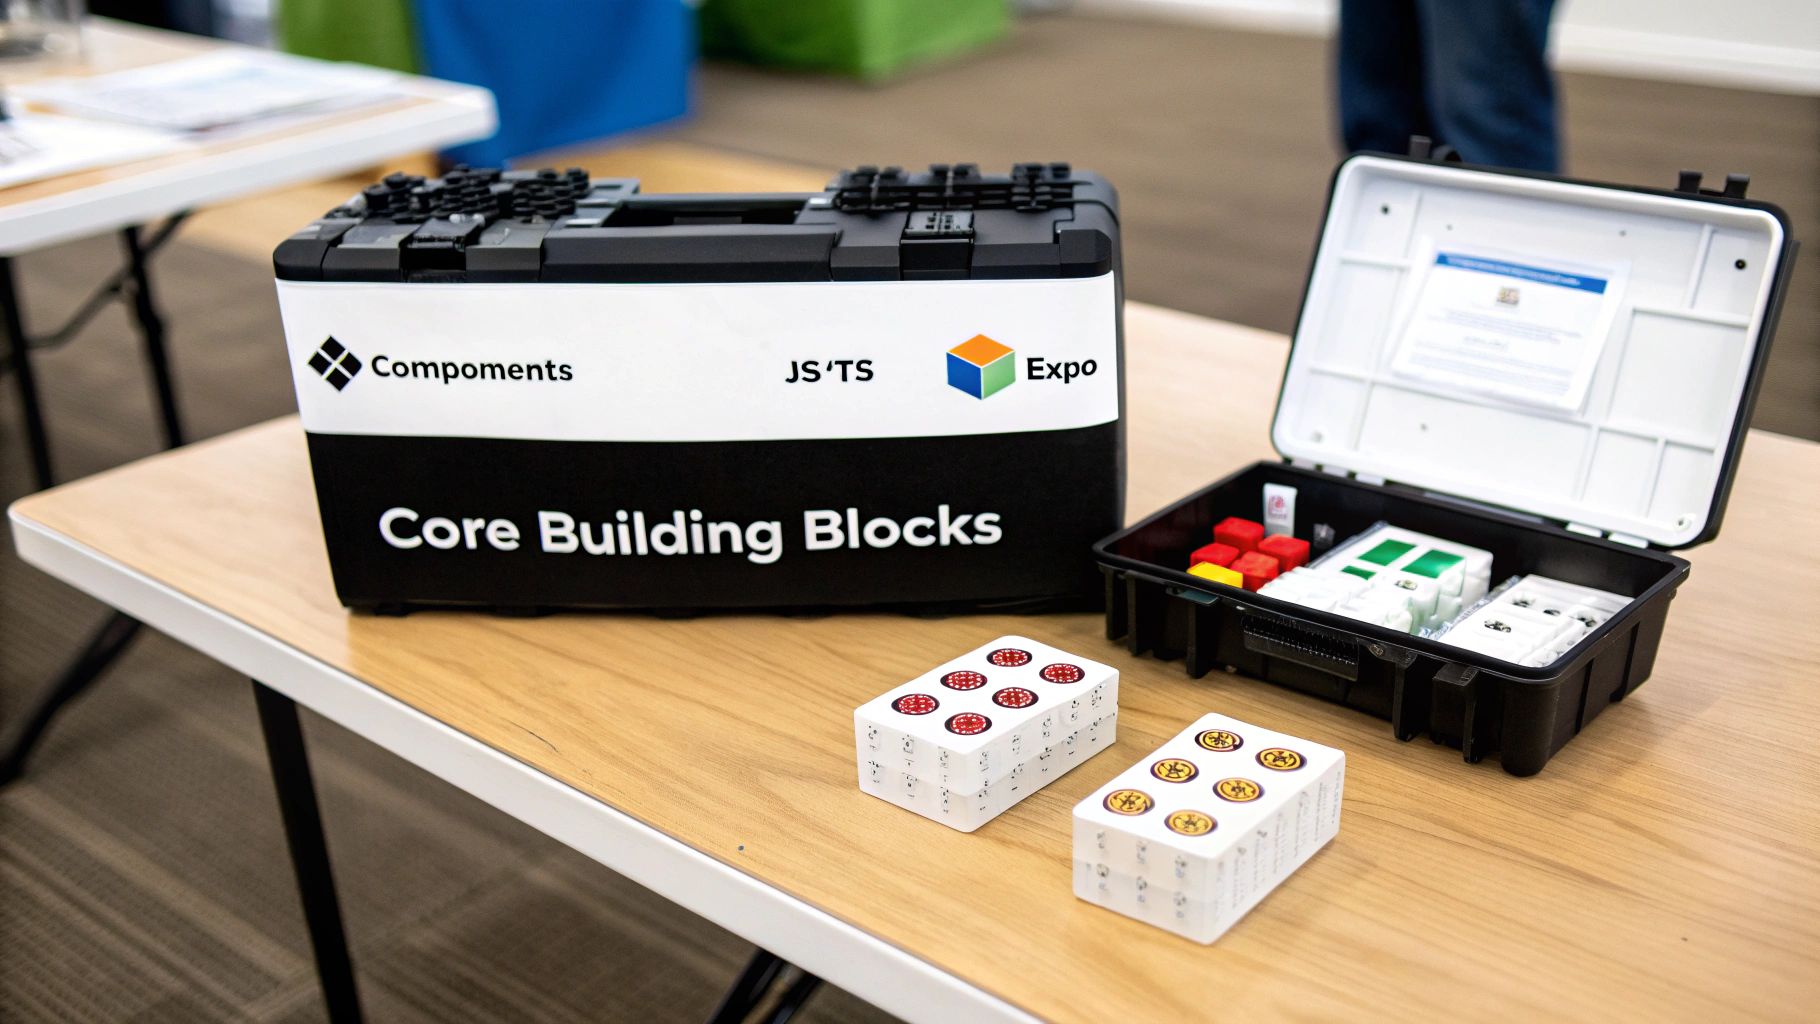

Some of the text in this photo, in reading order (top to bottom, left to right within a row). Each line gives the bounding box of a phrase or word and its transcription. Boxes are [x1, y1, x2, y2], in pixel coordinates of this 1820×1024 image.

[371, 355, 573, 385] Compoments
[1026, 357, 1098, 385] Expo
[379, 504, 1003, 564] Core Building Blocks
